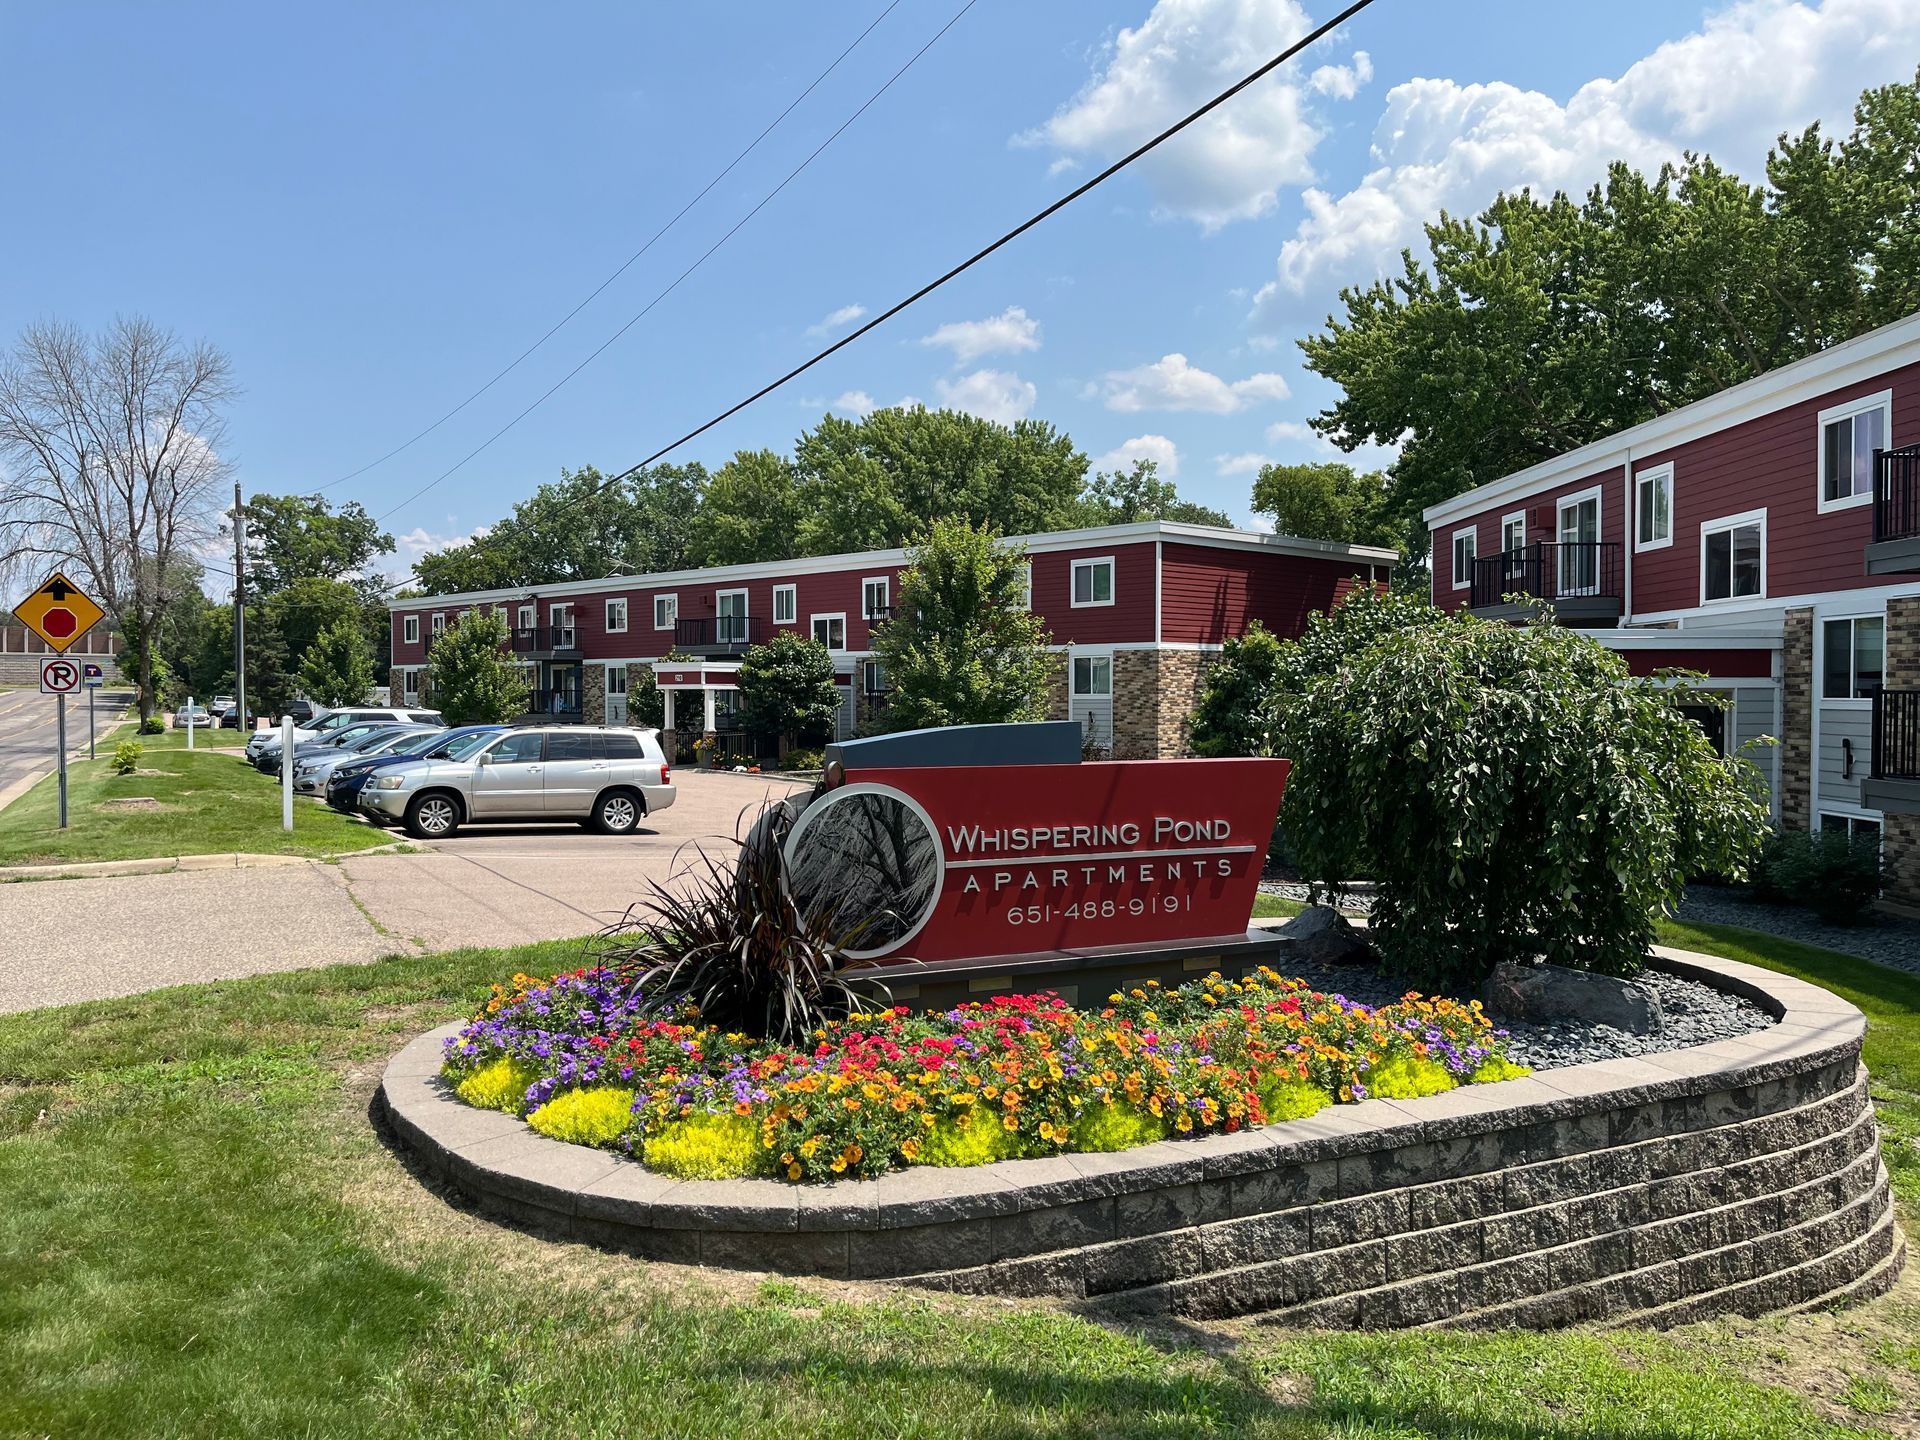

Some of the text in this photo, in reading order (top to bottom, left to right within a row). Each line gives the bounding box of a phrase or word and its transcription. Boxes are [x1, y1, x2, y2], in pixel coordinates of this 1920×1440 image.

[53, 666, 71, 685] P
[948, 816, 1231, 853] WHISPERING POND
[963, 859, 1232, 893] APARTMENTS
[1007, 894, 1190, 925] 651-488-9191
